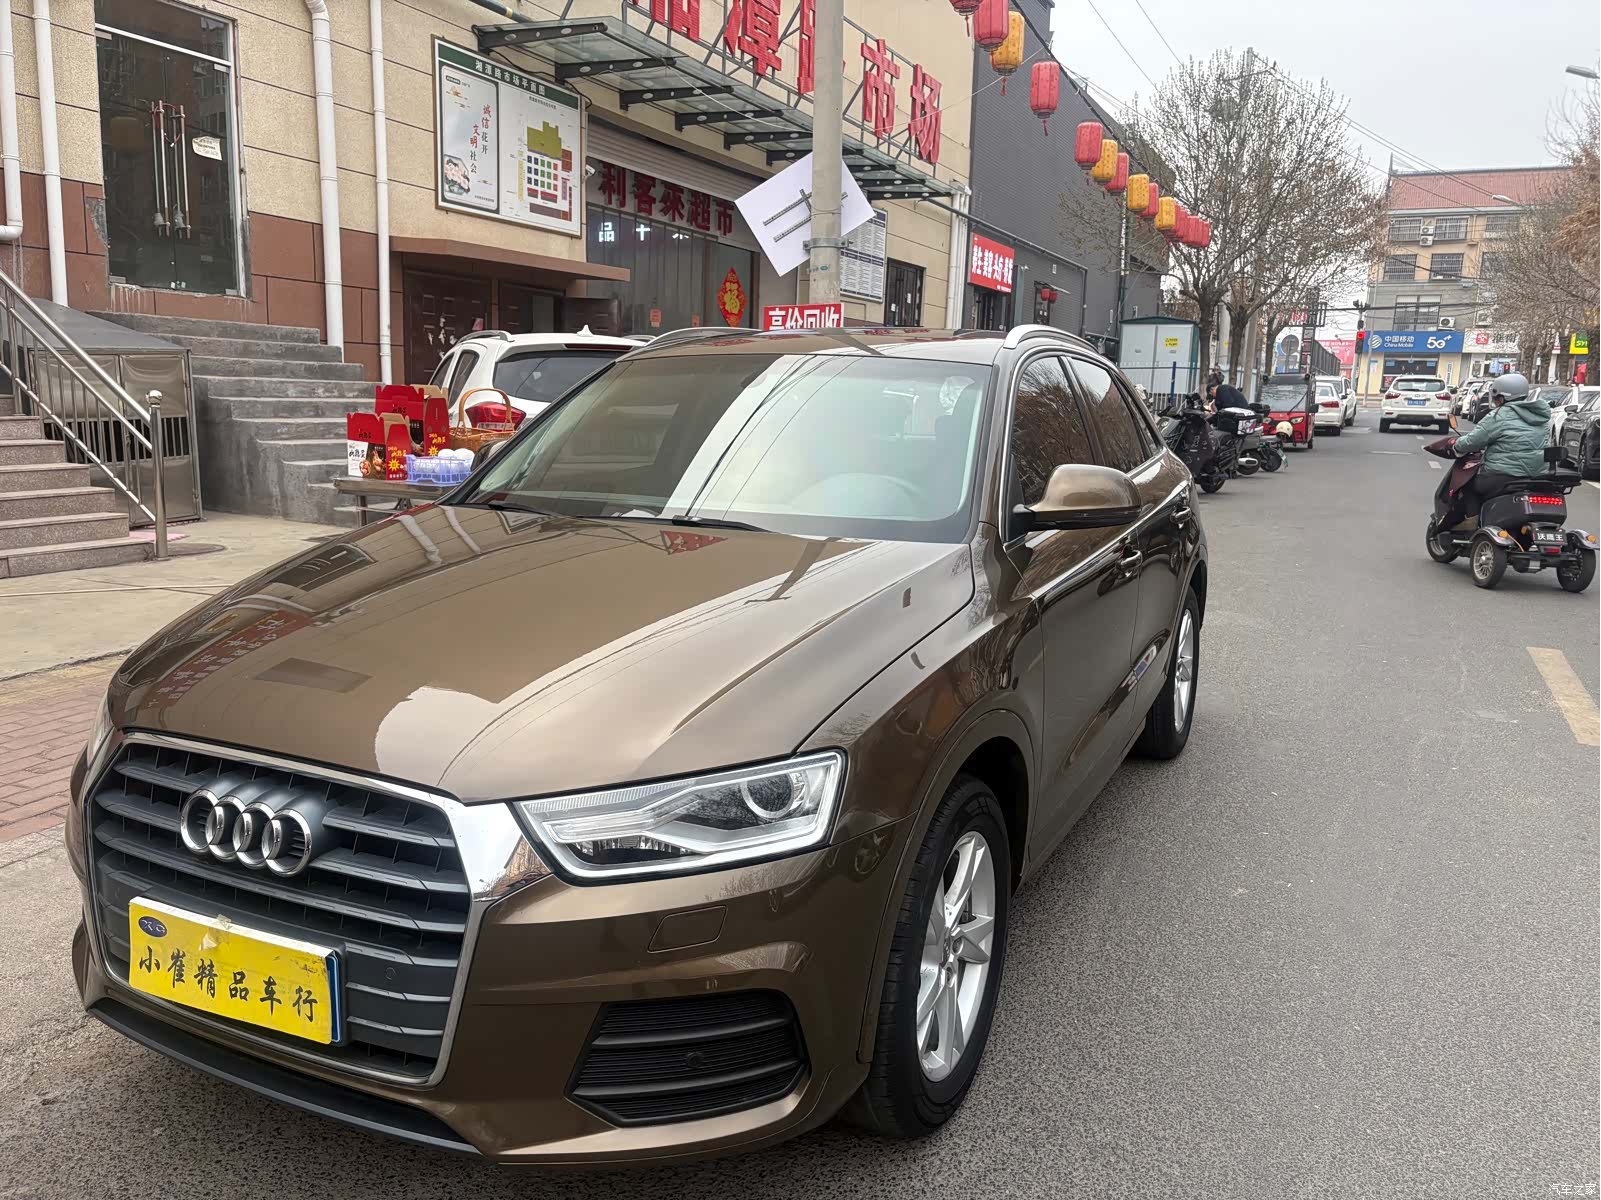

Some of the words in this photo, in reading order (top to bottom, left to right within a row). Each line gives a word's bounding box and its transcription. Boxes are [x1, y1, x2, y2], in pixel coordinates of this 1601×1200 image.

[475, 59, 546, 97] 湘潭路市场平面图
[470, 123, 480, 174] 文明社会
[481, 104, 491, 155] 诚信花开
[1384, 335, 1415, 343] 中国移动
[138, 946, 319, 1023] 小崔精品车行
